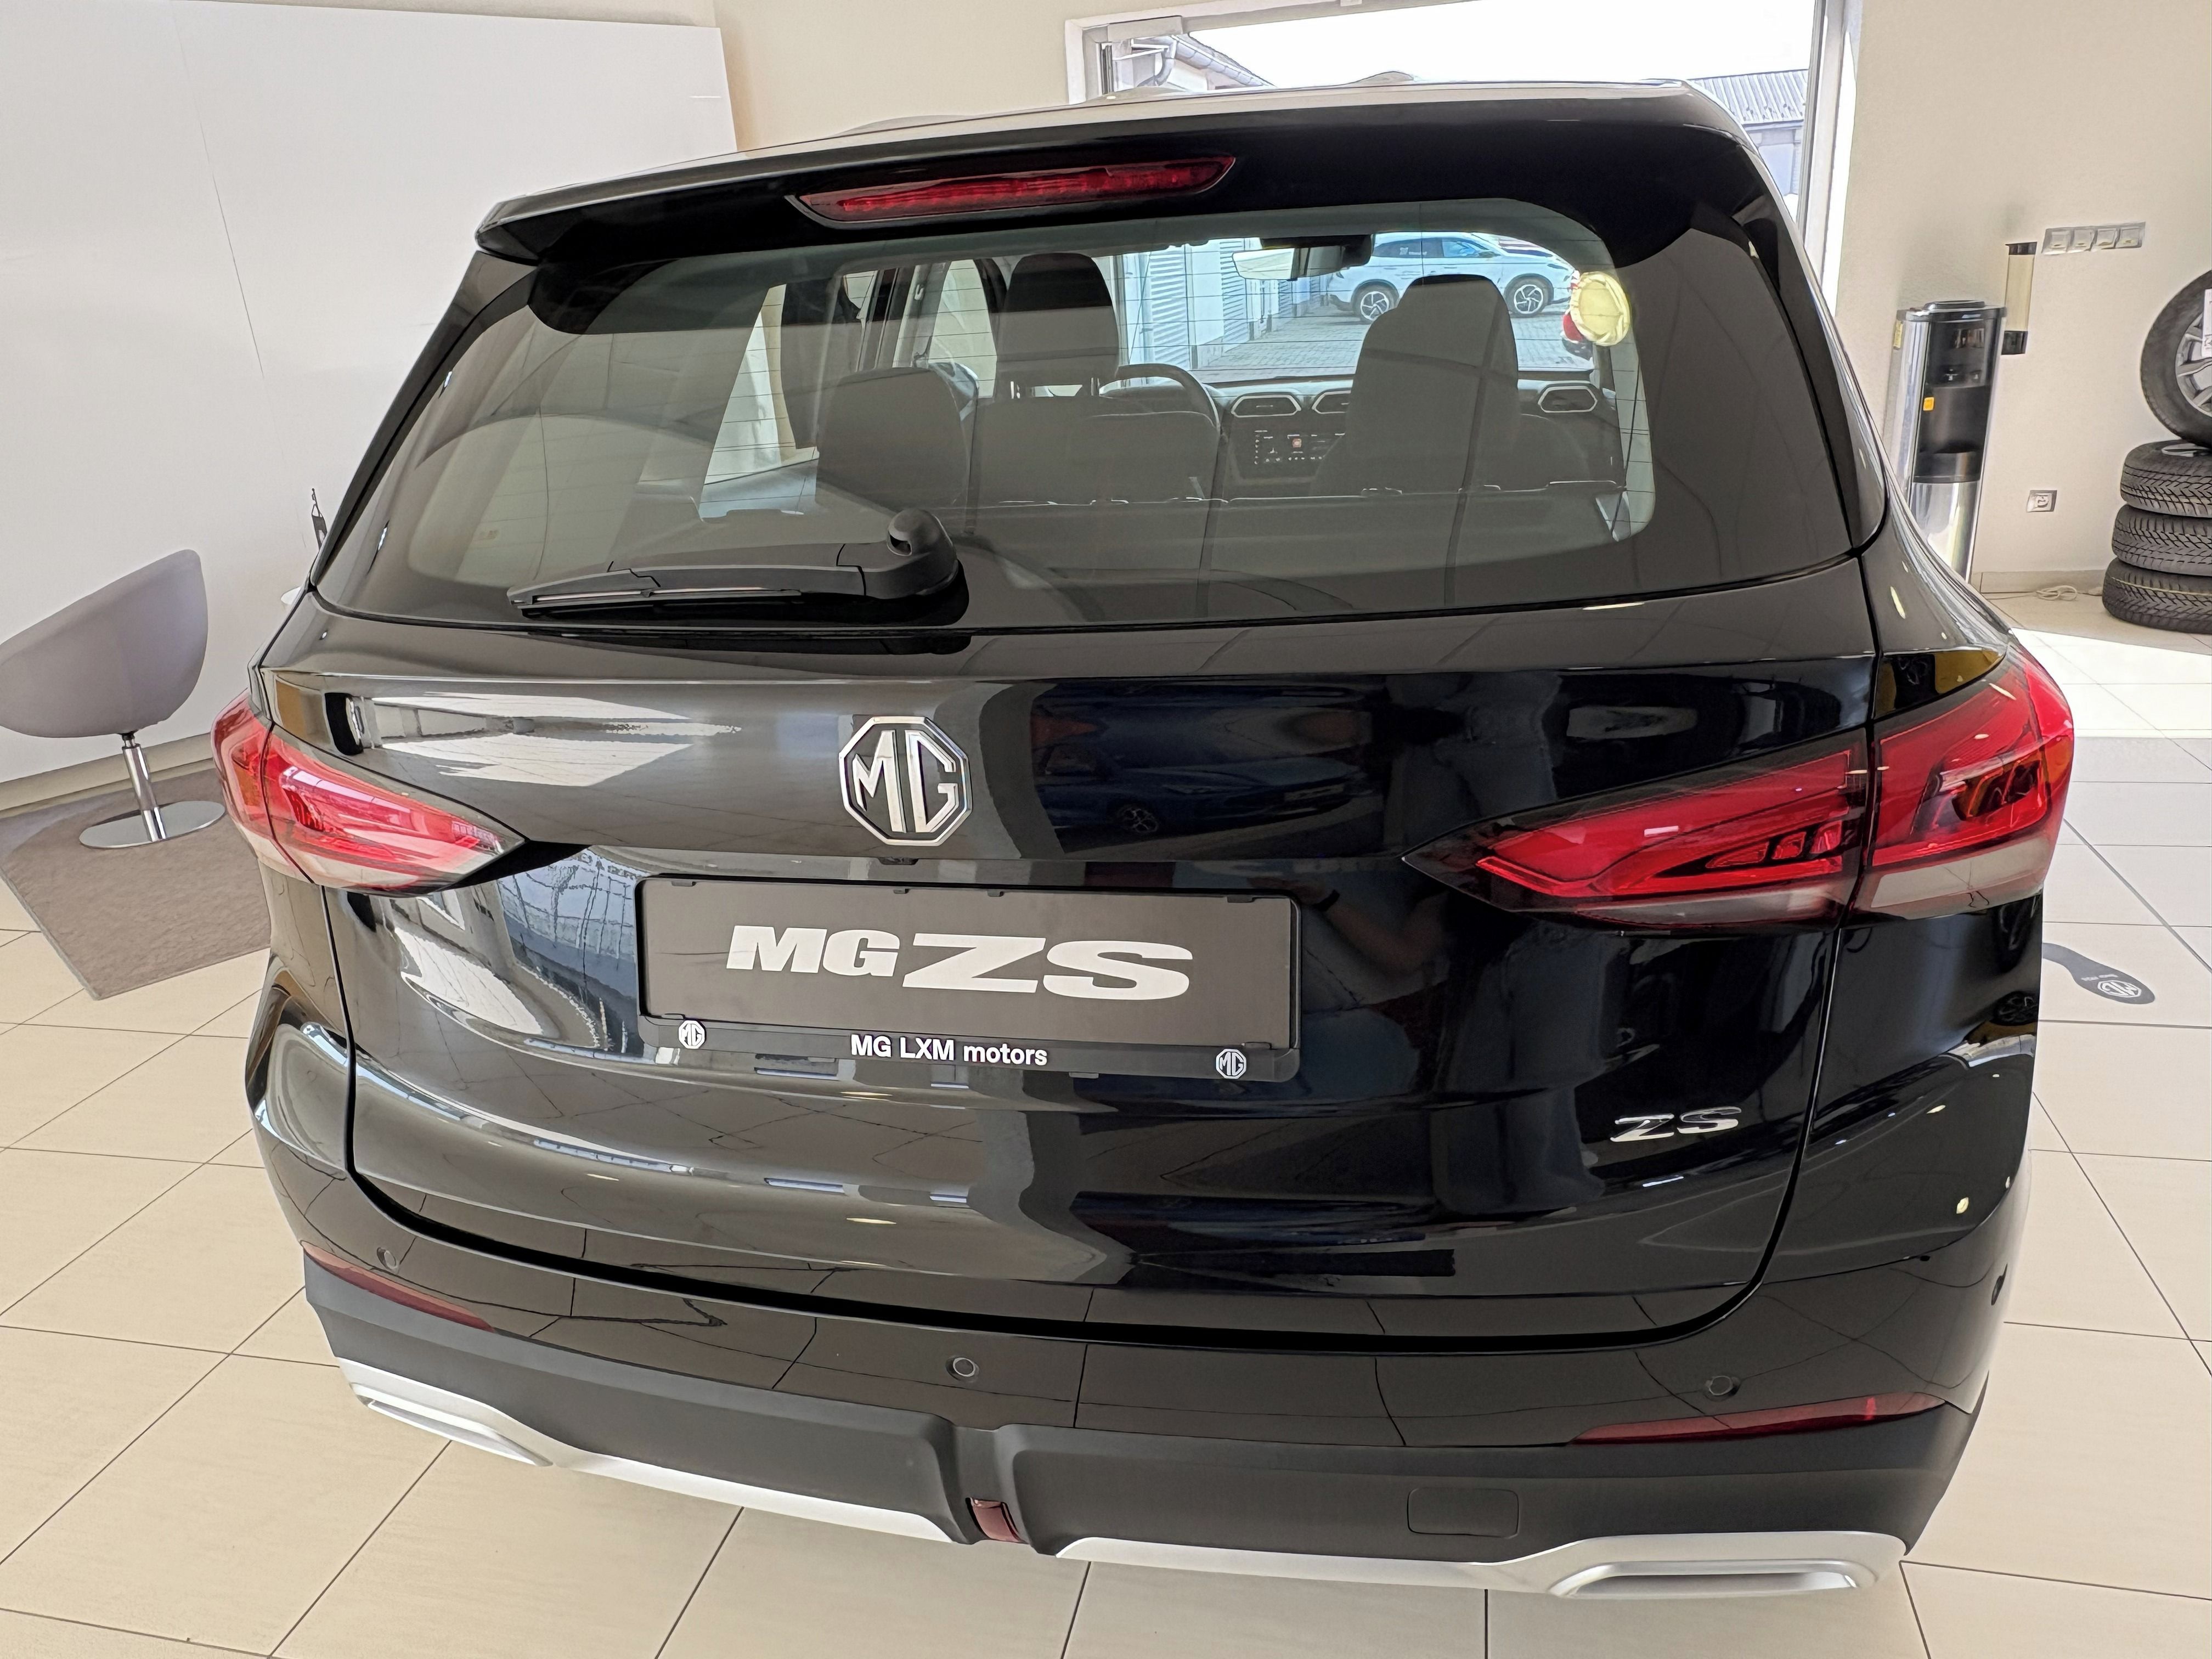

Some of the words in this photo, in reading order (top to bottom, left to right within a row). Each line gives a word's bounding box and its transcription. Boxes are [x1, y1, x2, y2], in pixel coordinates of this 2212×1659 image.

[852, 729, 960, 833] MG
[680, 1023, 703, 1047] MG
[850, 1034, 891, 1057] MG
[899, 1037, 954, 1061] LXM
[963, 1043, 1048, 1066] motors
[1218, 1051, 1245, 1076] MG
[1610, 1107, 1742, 1142] ZS
